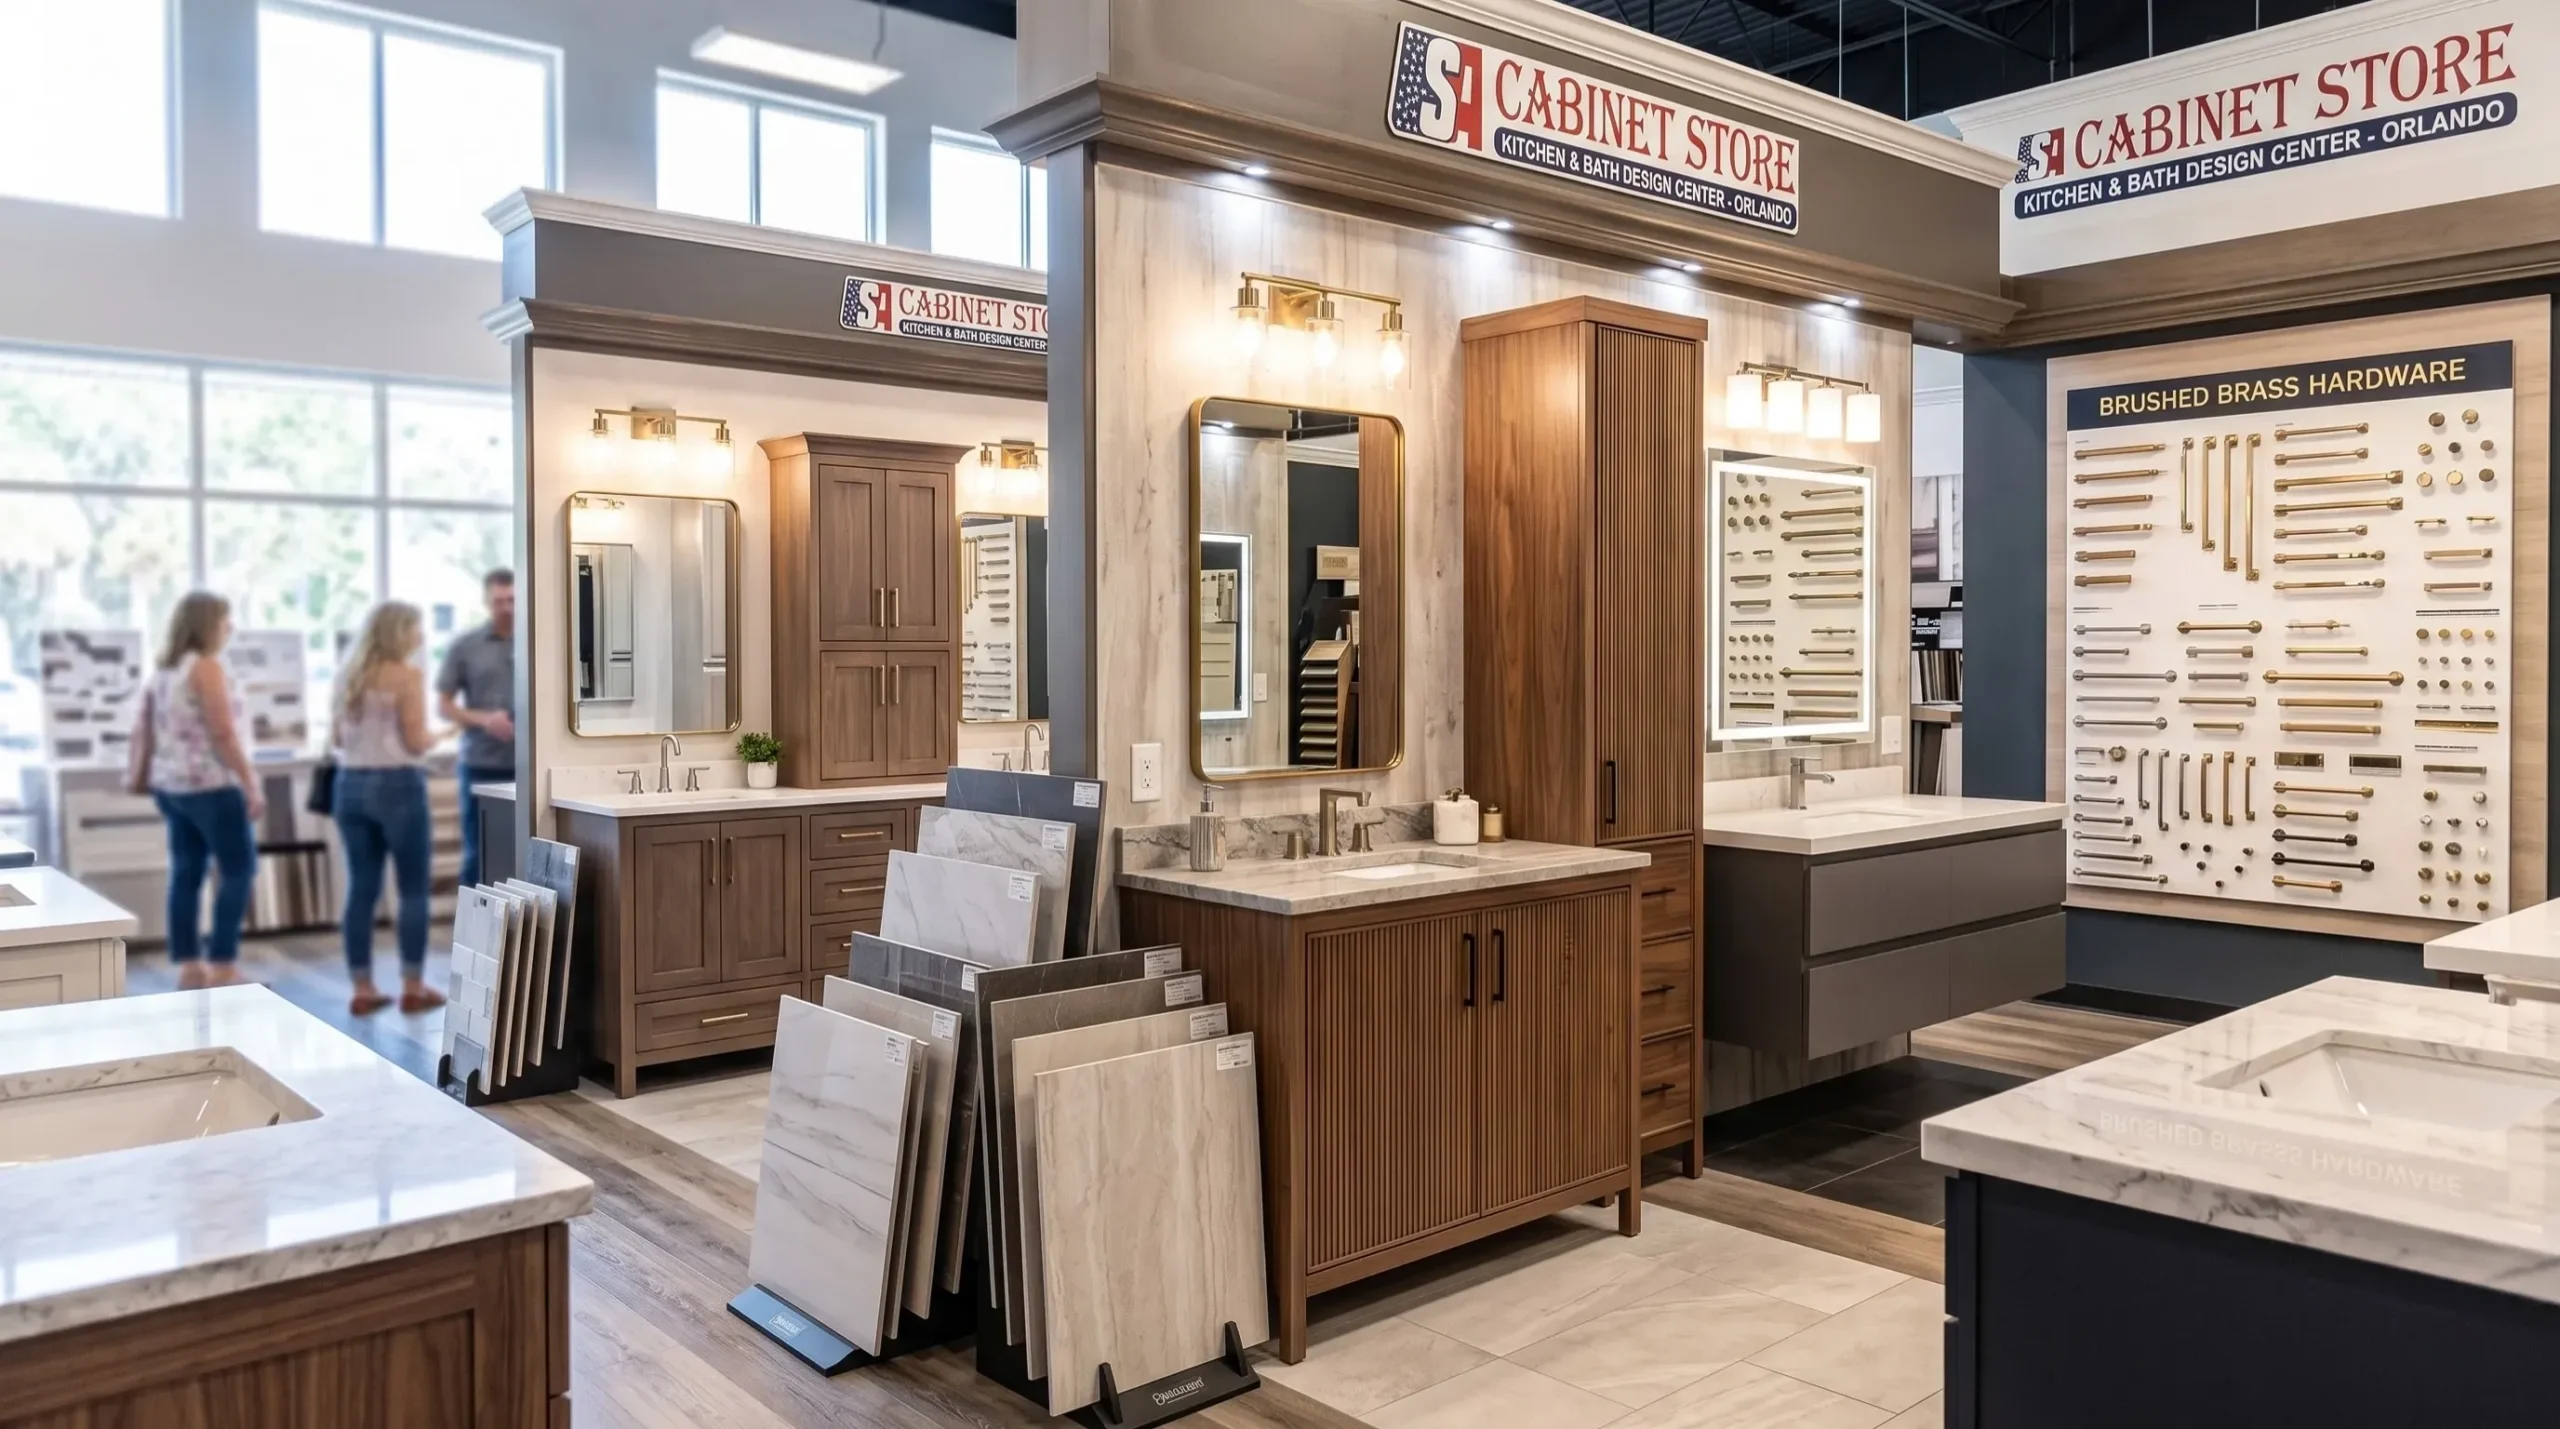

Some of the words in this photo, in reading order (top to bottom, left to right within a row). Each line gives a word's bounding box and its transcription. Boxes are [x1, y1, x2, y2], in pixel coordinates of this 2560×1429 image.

[1495, 60, 1676, 161] CABINET
[1685, 115, 1795, 194] STORE
[2075, 74, 2299, 169] CABINET
[2314, 23, 2516, 119] STORE
[1501, 133, 1566, 169] KITCHEN
[1569, 151, 1580, 172] &
[1583, 155, 1620, 182] BATH
[1623, 164, 1672, 195] DESIGN
[1675, 178, 1726, 210] CENTER
[1734, 194, 1793, 226] ORLANDO
[2023, 180, 2103, 214] KITCHEN
[2108, 177, 2122, 198] &
[2128, 165, 2180, 193] BATH
[2186, 151, 2264, 182] DESIGN
[2270, 128, 2361, 166] CENTER
[2381, 99, 2506, 144] ORLANDO
[898, 287, 1007, 328] CABINET
[902, 321, 943, 338] KITCHEN
[944, 327, 952, 338] &
[953, 329, 978, 342] BATH
[979, 332, 1012, 346] DESIGN
[2100, 387, 2209, 416] BRUSHED
[2218, 375, 2300, 405] BRASS
[2309, 358, 2466, 396] HARDWARE
